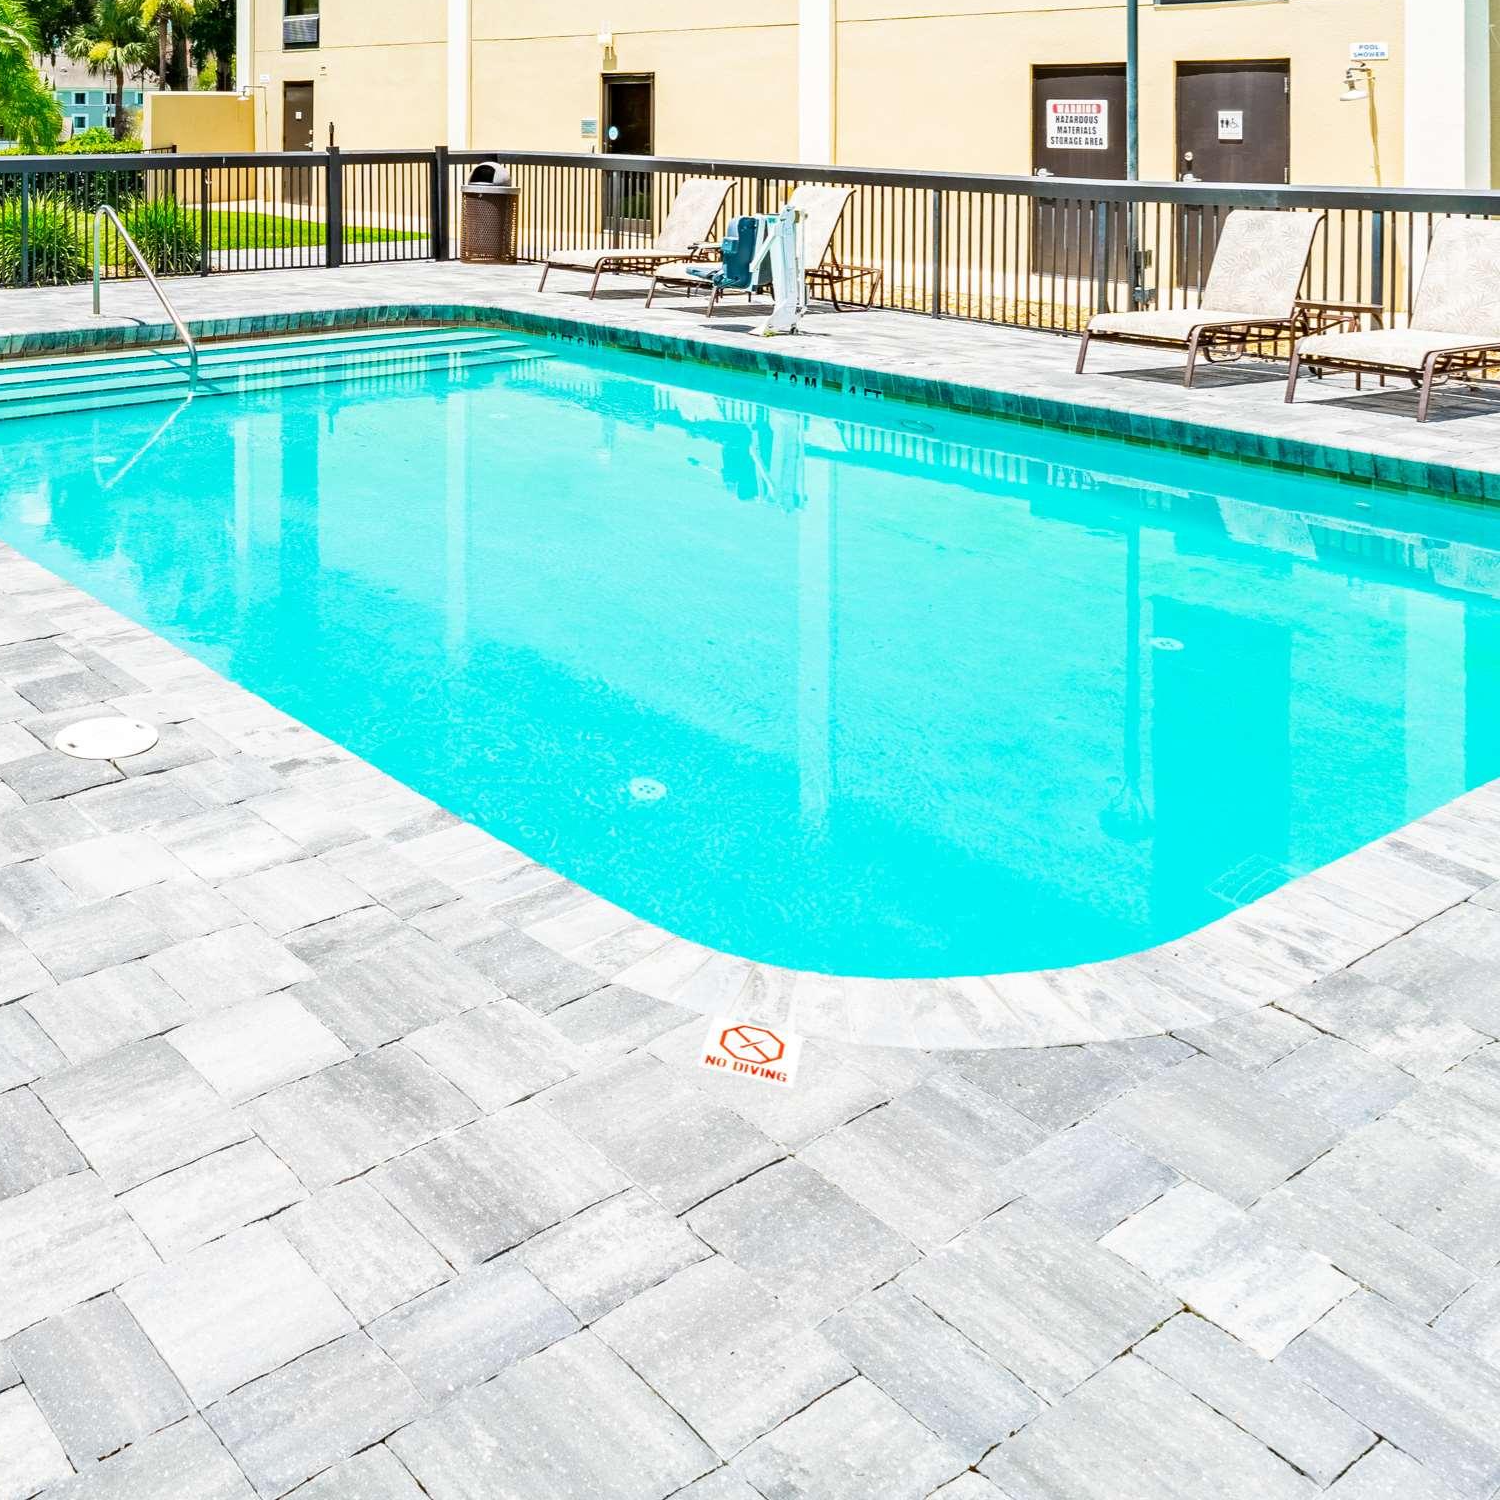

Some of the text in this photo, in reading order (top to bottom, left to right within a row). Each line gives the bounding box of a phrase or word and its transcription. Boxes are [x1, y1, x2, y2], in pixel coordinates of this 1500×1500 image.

[1055, 115, 1099, 124] HAZARDOUS
[1056, 126, 1097, 135] MATERIALS
[1050, 136, 1104, 146] STORAGE AREA
[705, 1054, 788, 1083] NO DIVING
